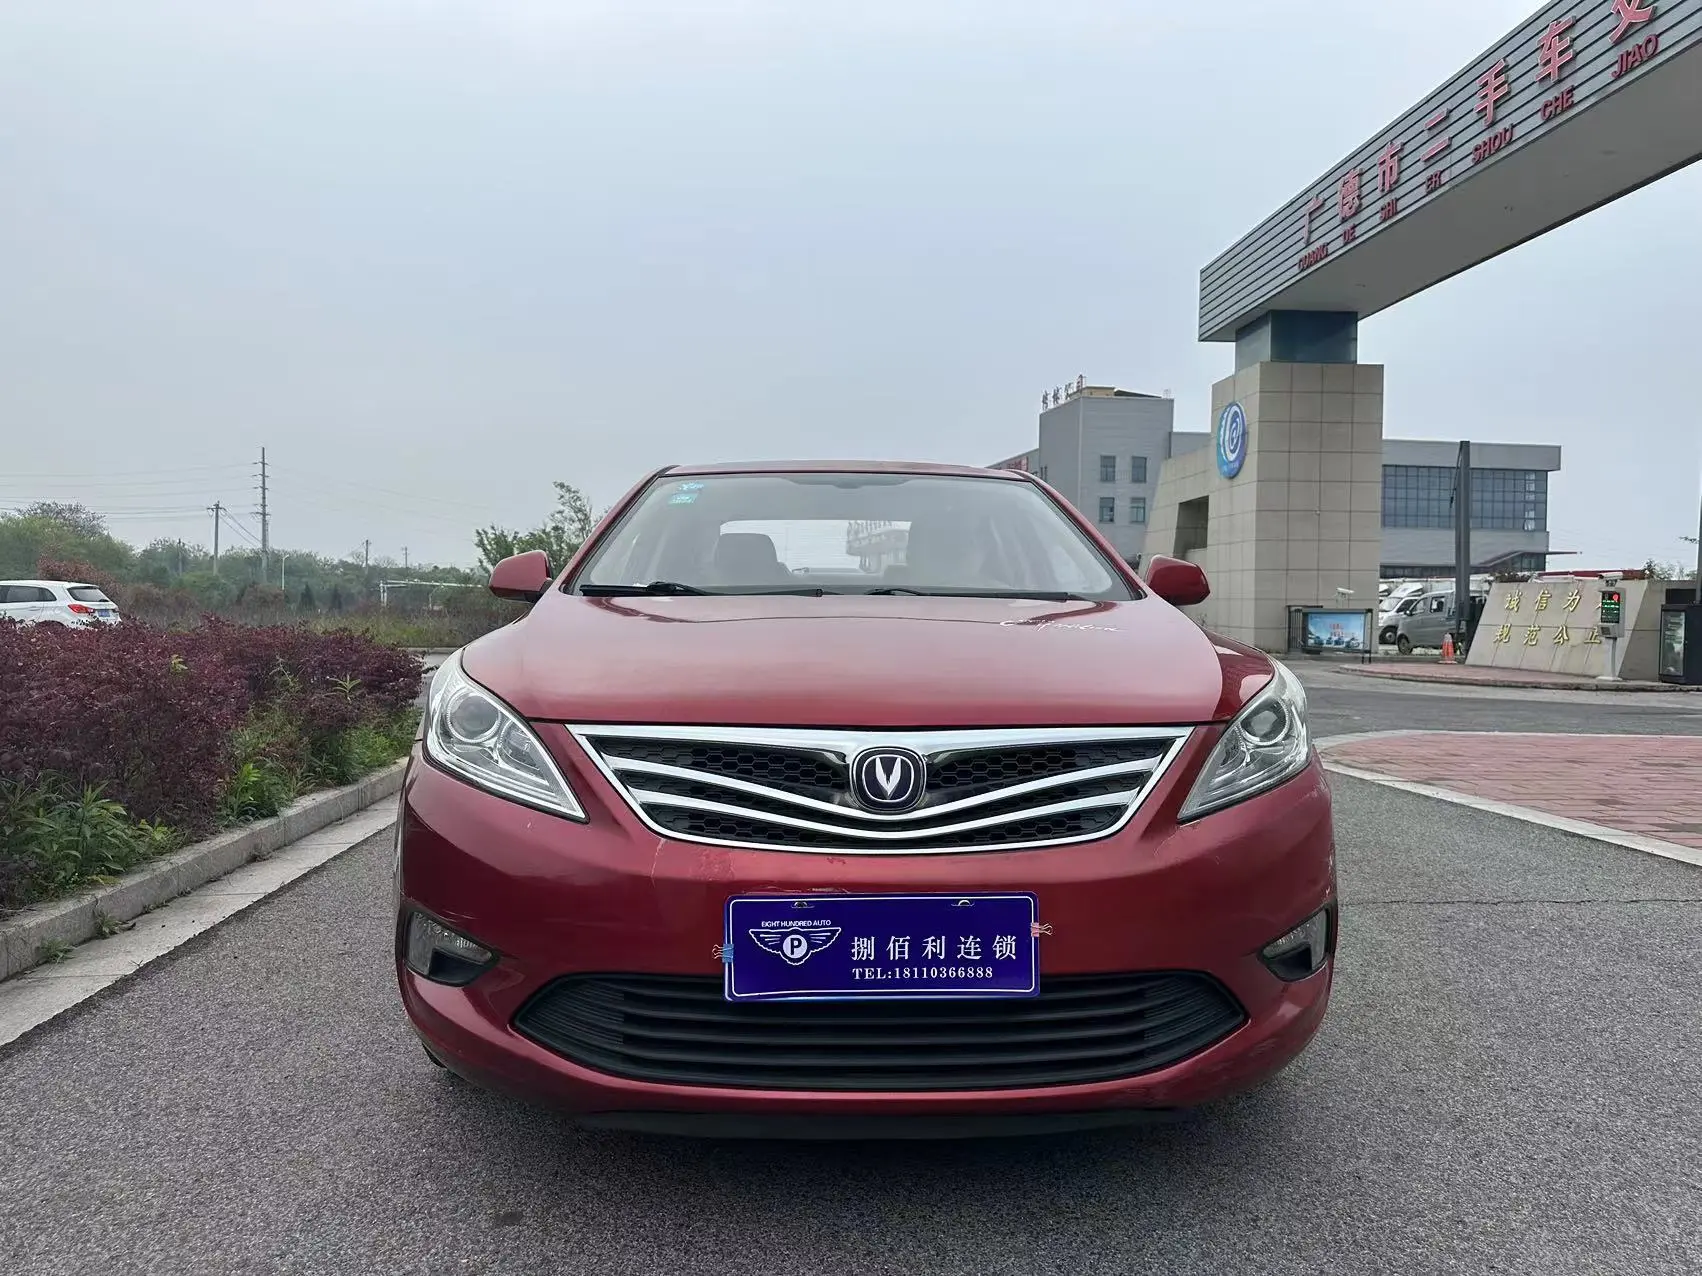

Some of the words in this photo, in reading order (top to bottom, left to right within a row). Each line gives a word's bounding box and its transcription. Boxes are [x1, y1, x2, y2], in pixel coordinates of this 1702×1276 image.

[1299, 242, 1329, 269] GUANG
[1342, 223, 1357, 245] DE
[1379, 197, 1398, 222] SHI
[1425, 169, 1442, 191] ER
[1472, 123, 1514, 164] SHOU
[1541, 85, 1575, 120] CHE
[1611, 33, 1659, 79] JIAO
[1504, 590, 1602, 612] 诚信为
[761, 920, 780, 928] EIGHT
[813, 919, 832, 927] AUTO
[851, 935, 1017, 961] 捌佰利连锁
[852, 967, 994, 980] TEL:18110366888
